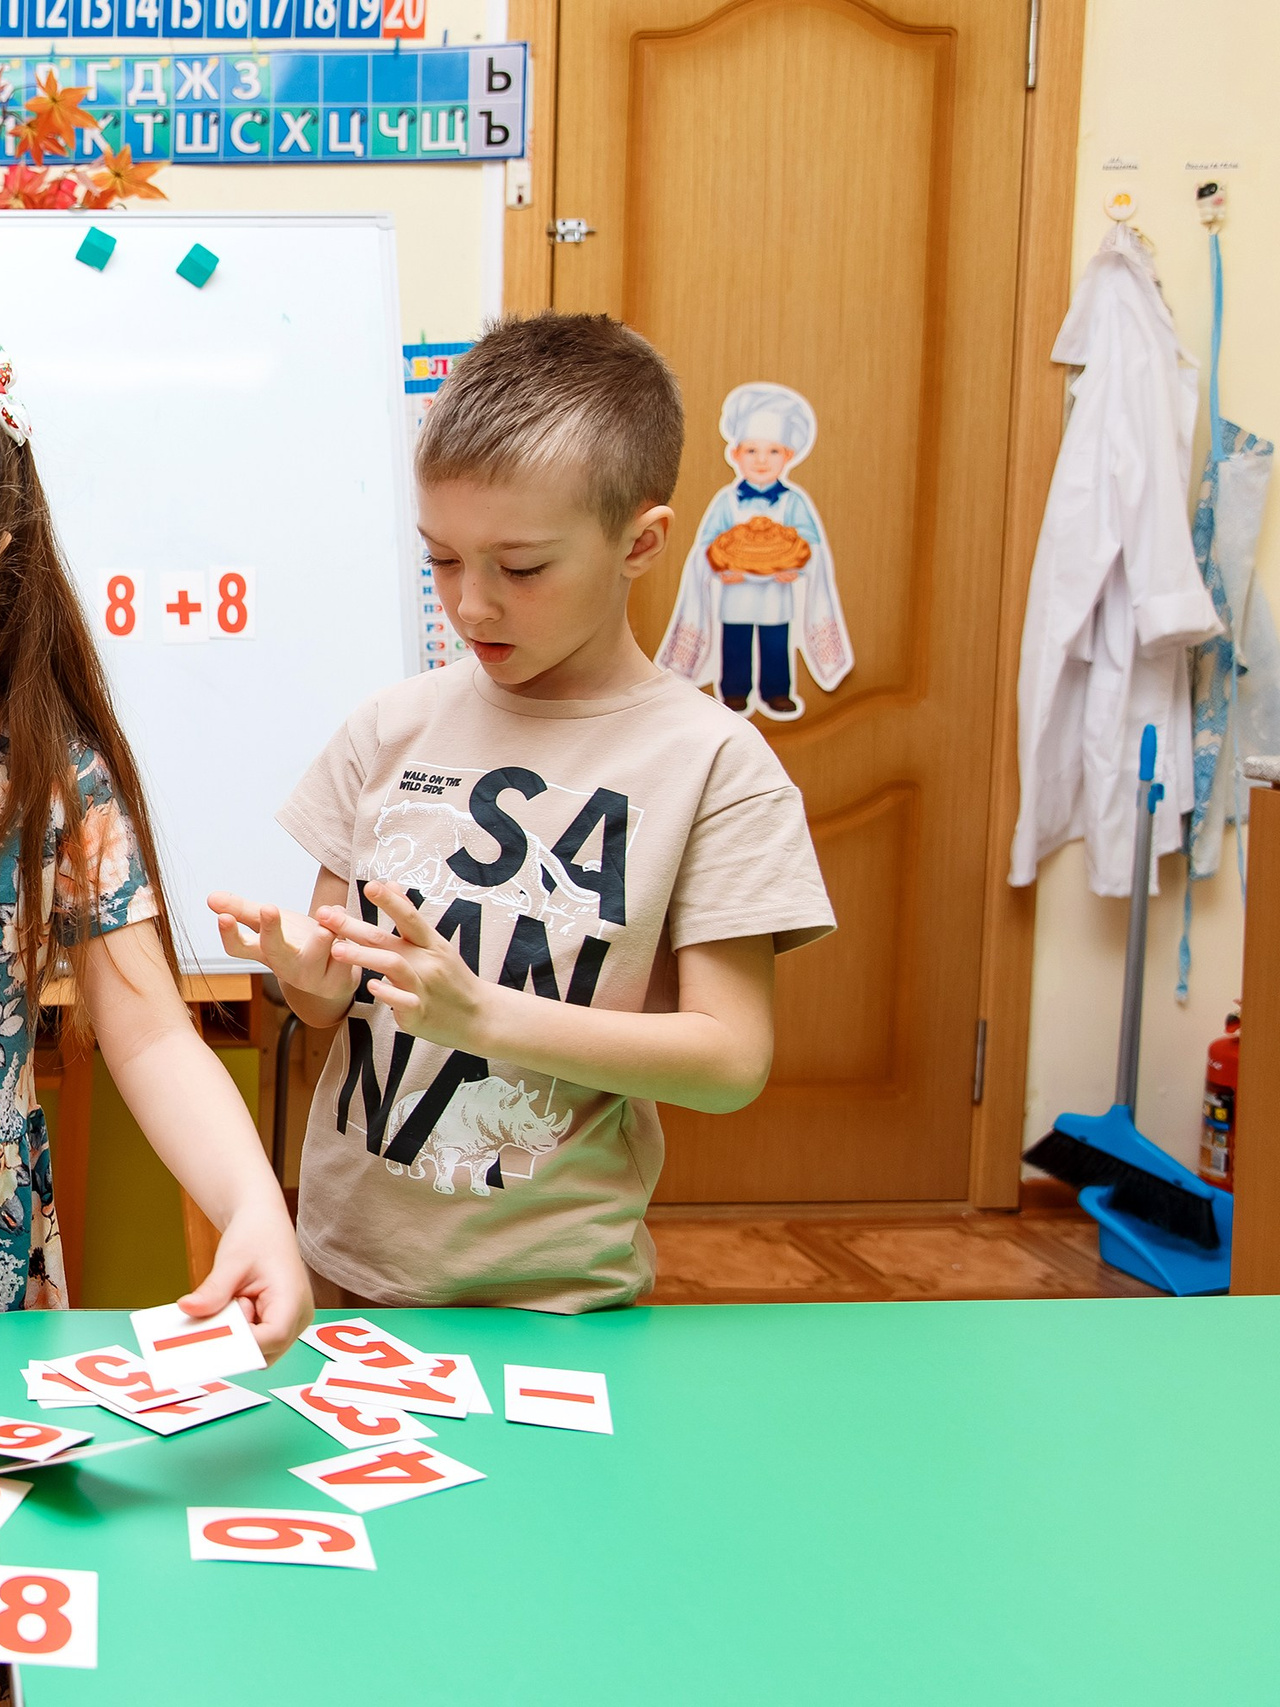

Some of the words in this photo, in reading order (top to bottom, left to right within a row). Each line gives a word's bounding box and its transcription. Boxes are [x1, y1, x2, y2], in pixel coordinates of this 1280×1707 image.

[37, 0, 67, 30] 12
[81, 0, 112, 30] 13
[125, 0, 159, 30] 14
[172, 0, 202, 30] 15
[215, 0, 248, 30] 16
[262, 0, 294, 30] 17
[304, 0, 336, 30] 18
[349, 0, 380, 30] 19
[384, 0, 424, 30] 20
[86, 62, 113, 101] Г
[128, 62, 167, 106] Д
[175, 62, 219, 101] Ж
[232, 61, 261, 100] З
[133, 114, 166, 154] Т
[175, 114, 219, 154] Ш
[230, 113, 262, 155] С
[278, 113, 312, 152] Х
[328, 113, 364, 158] Ц
[378, 112, 407, 152] Ч
[422, 111, 467, 155] Щ
[479, 111, 510, 147] Ъ
[106, 575, 136, 636] 8
[218, 572, 248, 634] 8
[399, 780, 421, 791] WILD
[422, 784, 445, 795] SIDE
[403, 770, 428, 782] WALK
[429, 775, 444, 785] ON
[445, 777, 462, 787] THE
[316, 1325, 414, 1369] 5
